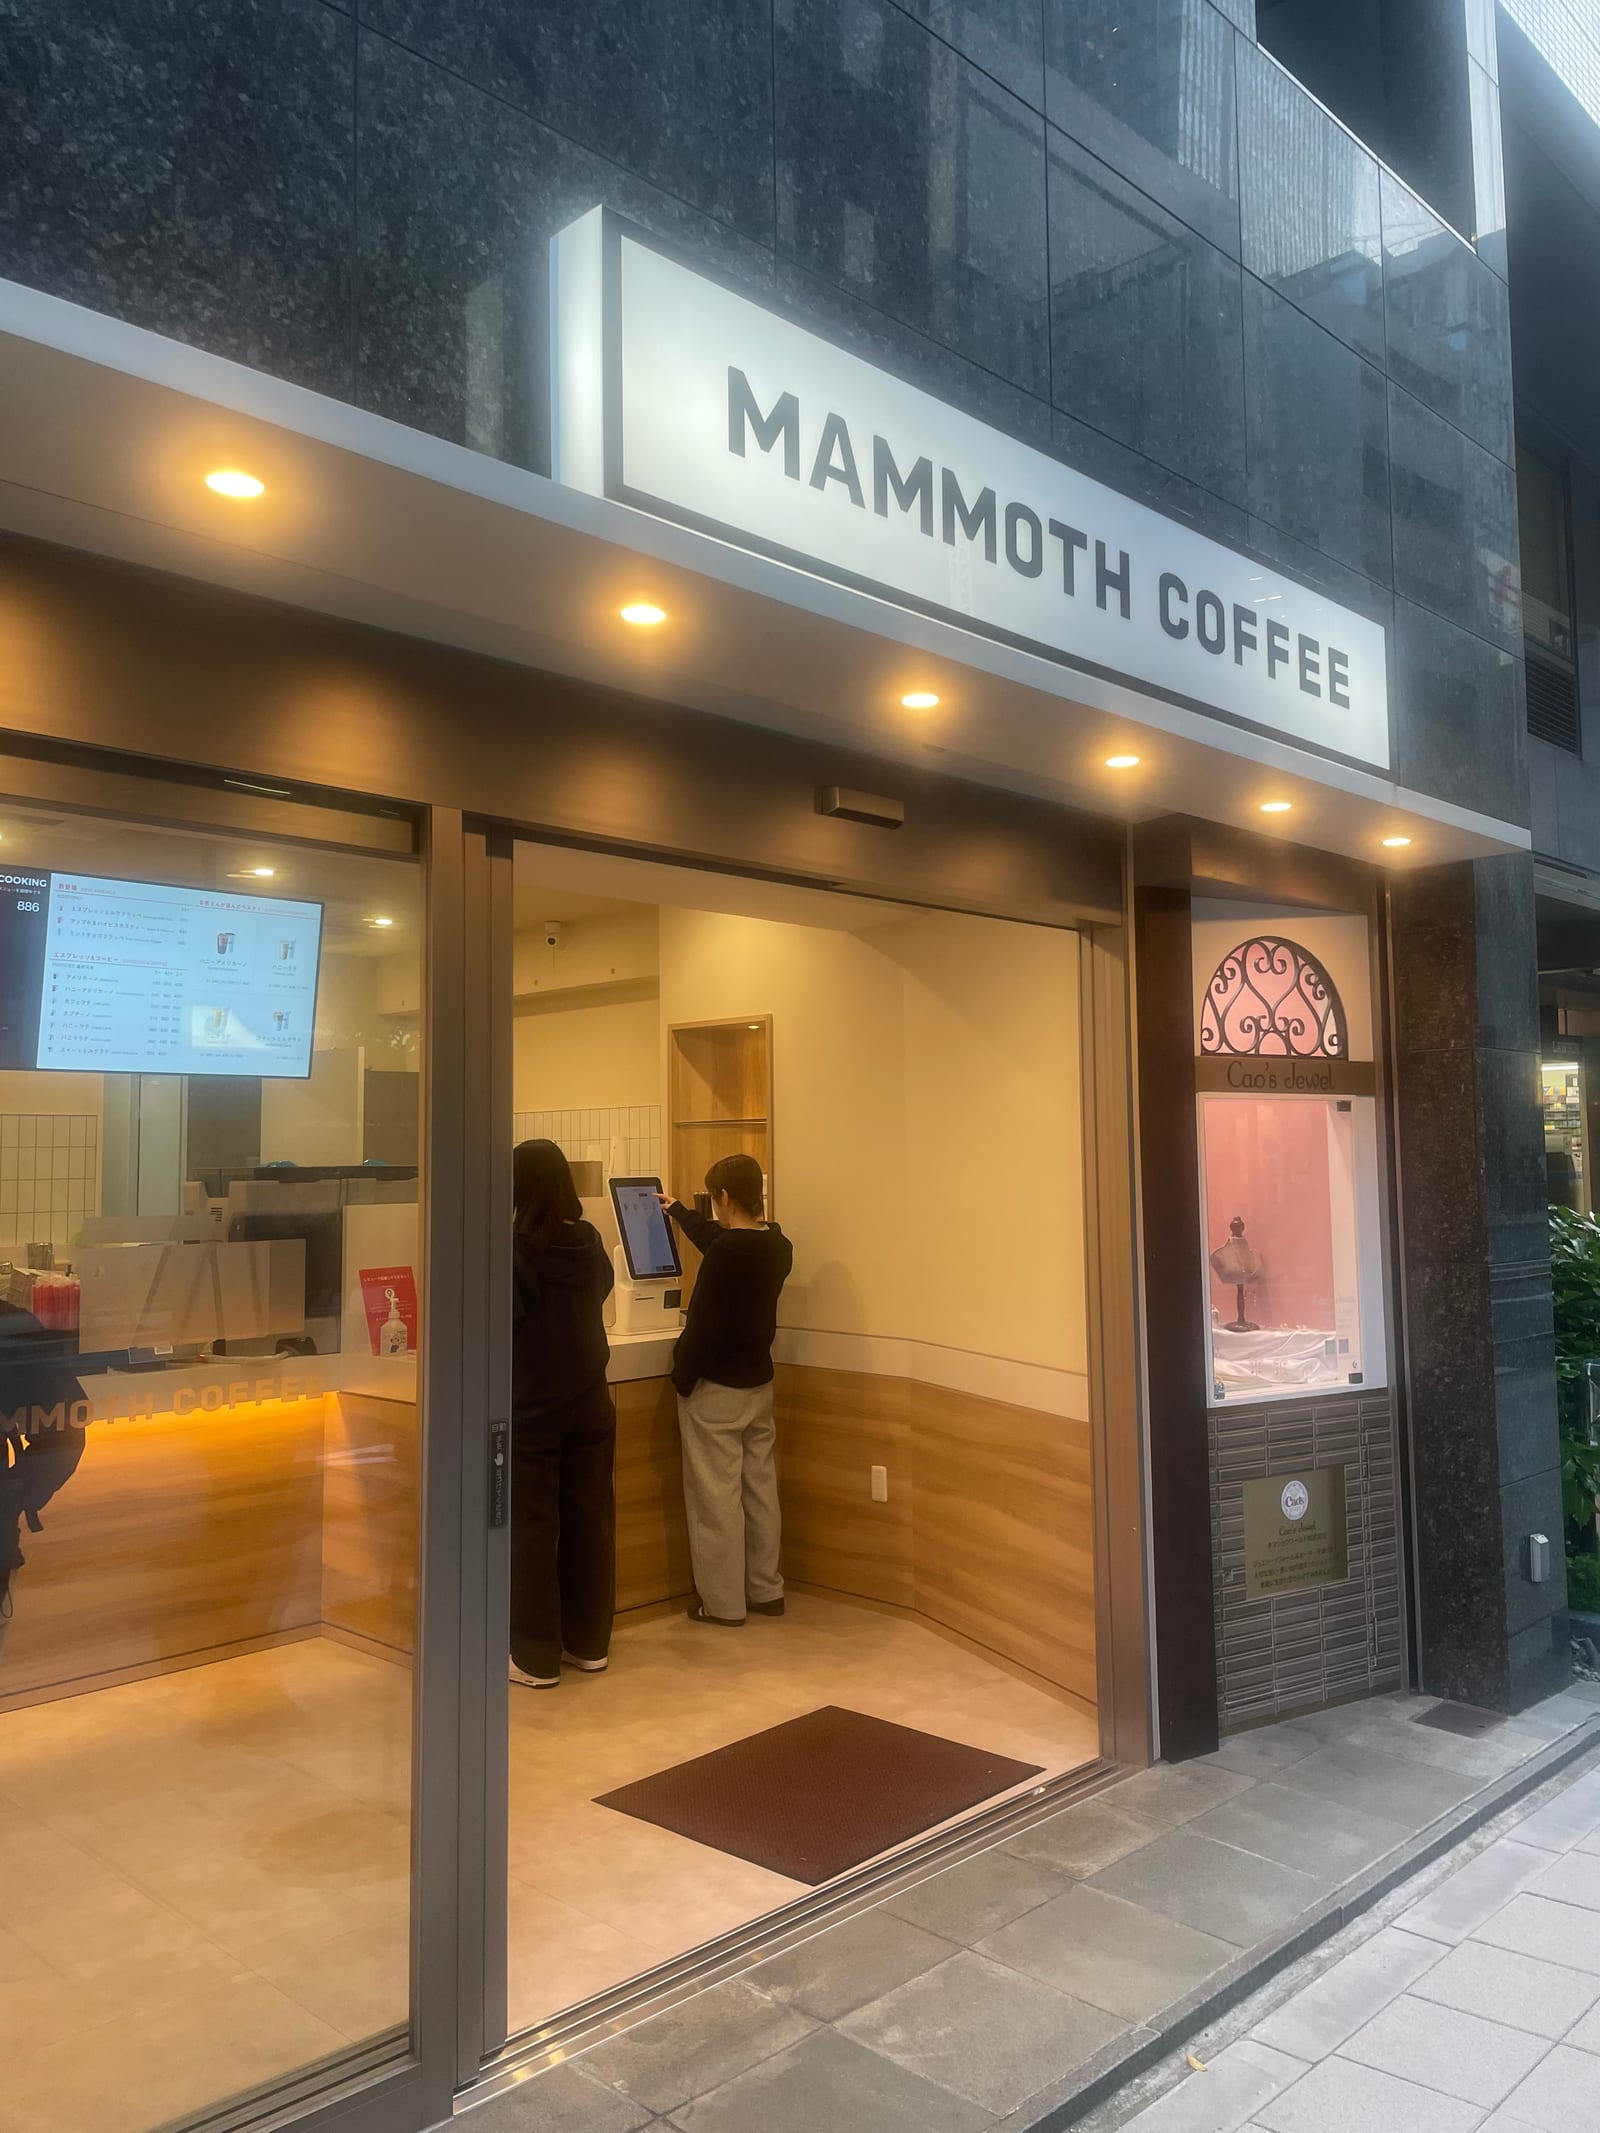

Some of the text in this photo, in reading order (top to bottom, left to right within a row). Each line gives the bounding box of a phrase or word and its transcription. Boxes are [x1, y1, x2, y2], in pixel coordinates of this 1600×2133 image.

[728, 365, 1350, 710] MAMMOTH COFFEE
[0, 874, 47, 887] COOKING
[17, 900, 40, 912] 886
[1227, 1060, 1335, 1091] Cao's Jewel
[172, 1375, 324, 1416] COFFEE
